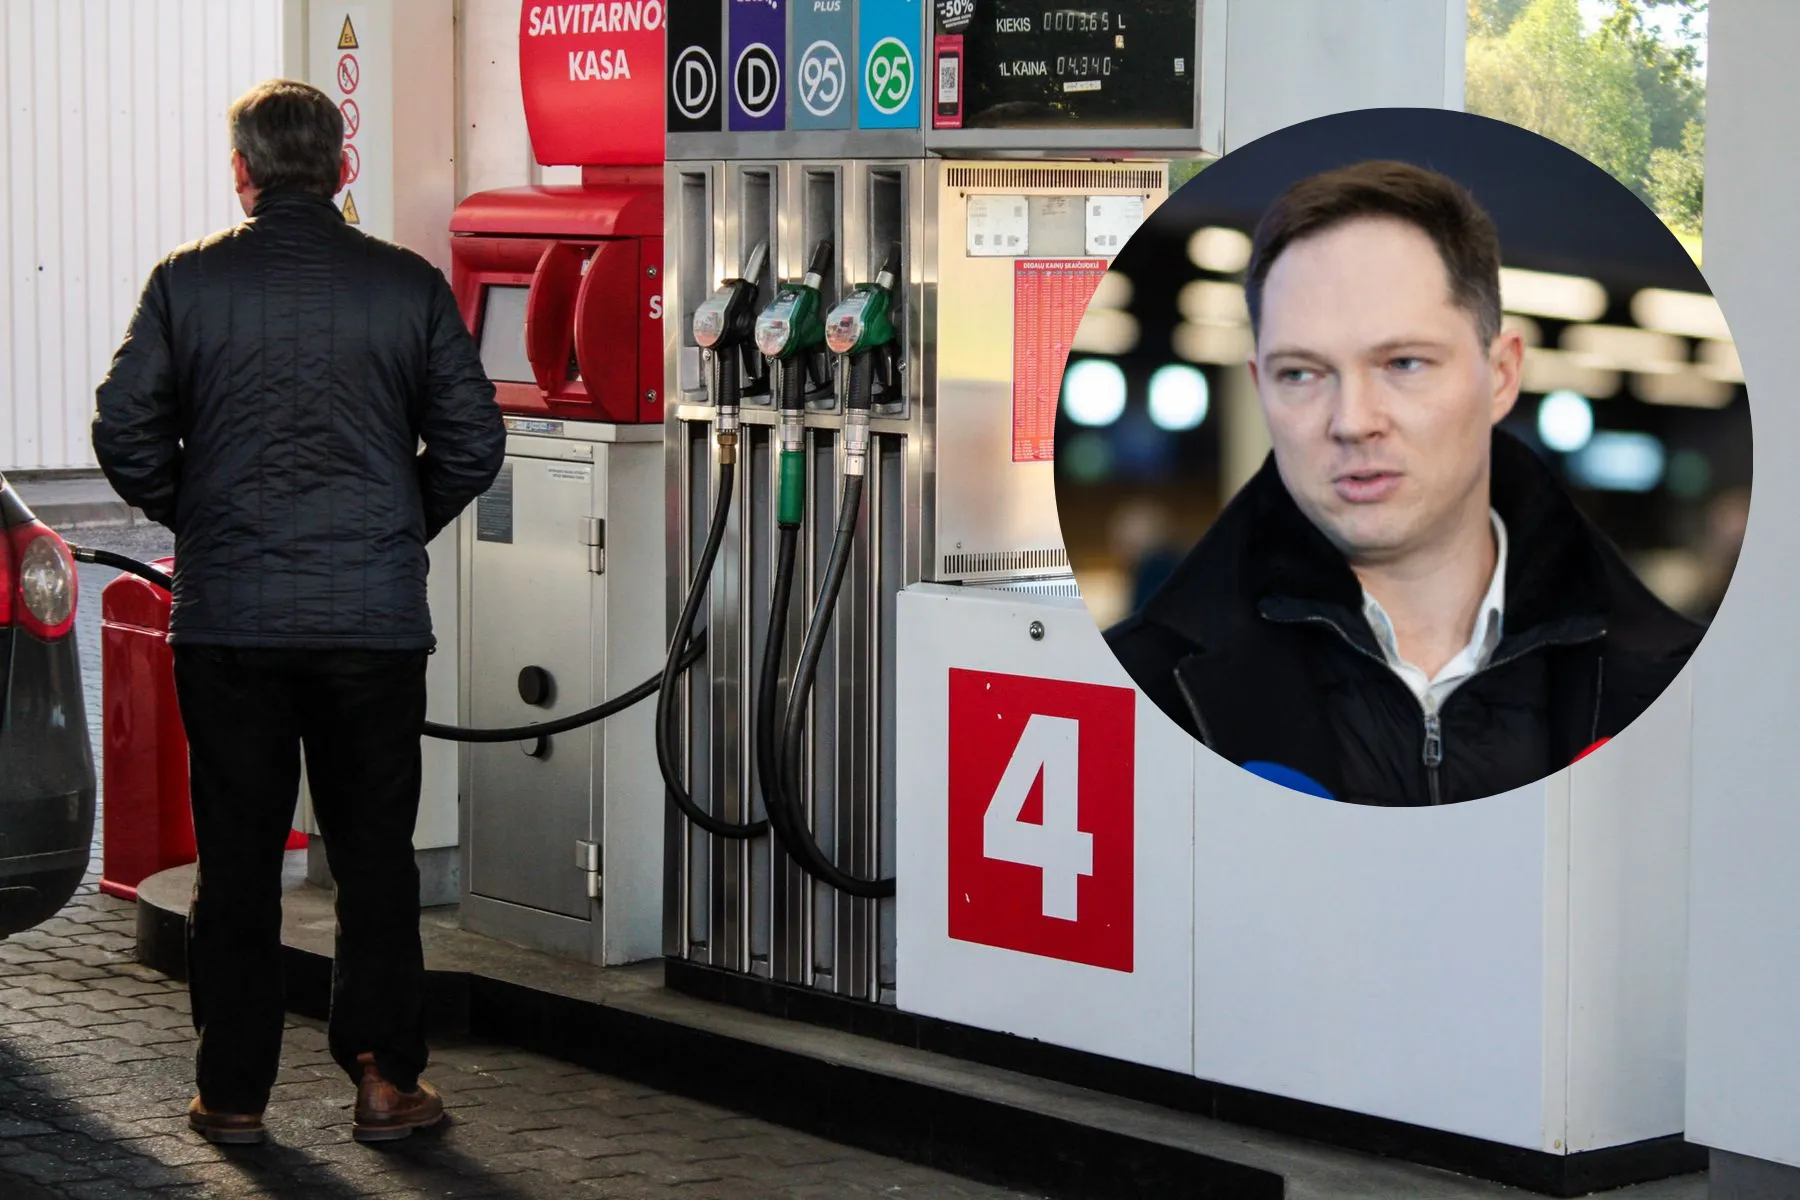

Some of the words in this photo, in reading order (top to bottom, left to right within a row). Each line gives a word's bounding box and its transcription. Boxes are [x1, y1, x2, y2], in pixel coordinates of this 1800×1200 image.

[813, 0, 841, 12] PLUS
[996, 17, 1031, 33] KIEKIS
[1118, 14, 1126, 29] L
[568, 49, 631, 81] KASA
[685, 60, 707, 106] D
[747, 58, 771, 104] D
[804, 57, 839, 102] 95
[872, 56, 907, 101] 95
[999, 61, 1011, 77] 1L
[1013, 60, 1048, 76] KAINA
[983, 713, 1094, 922] 4
